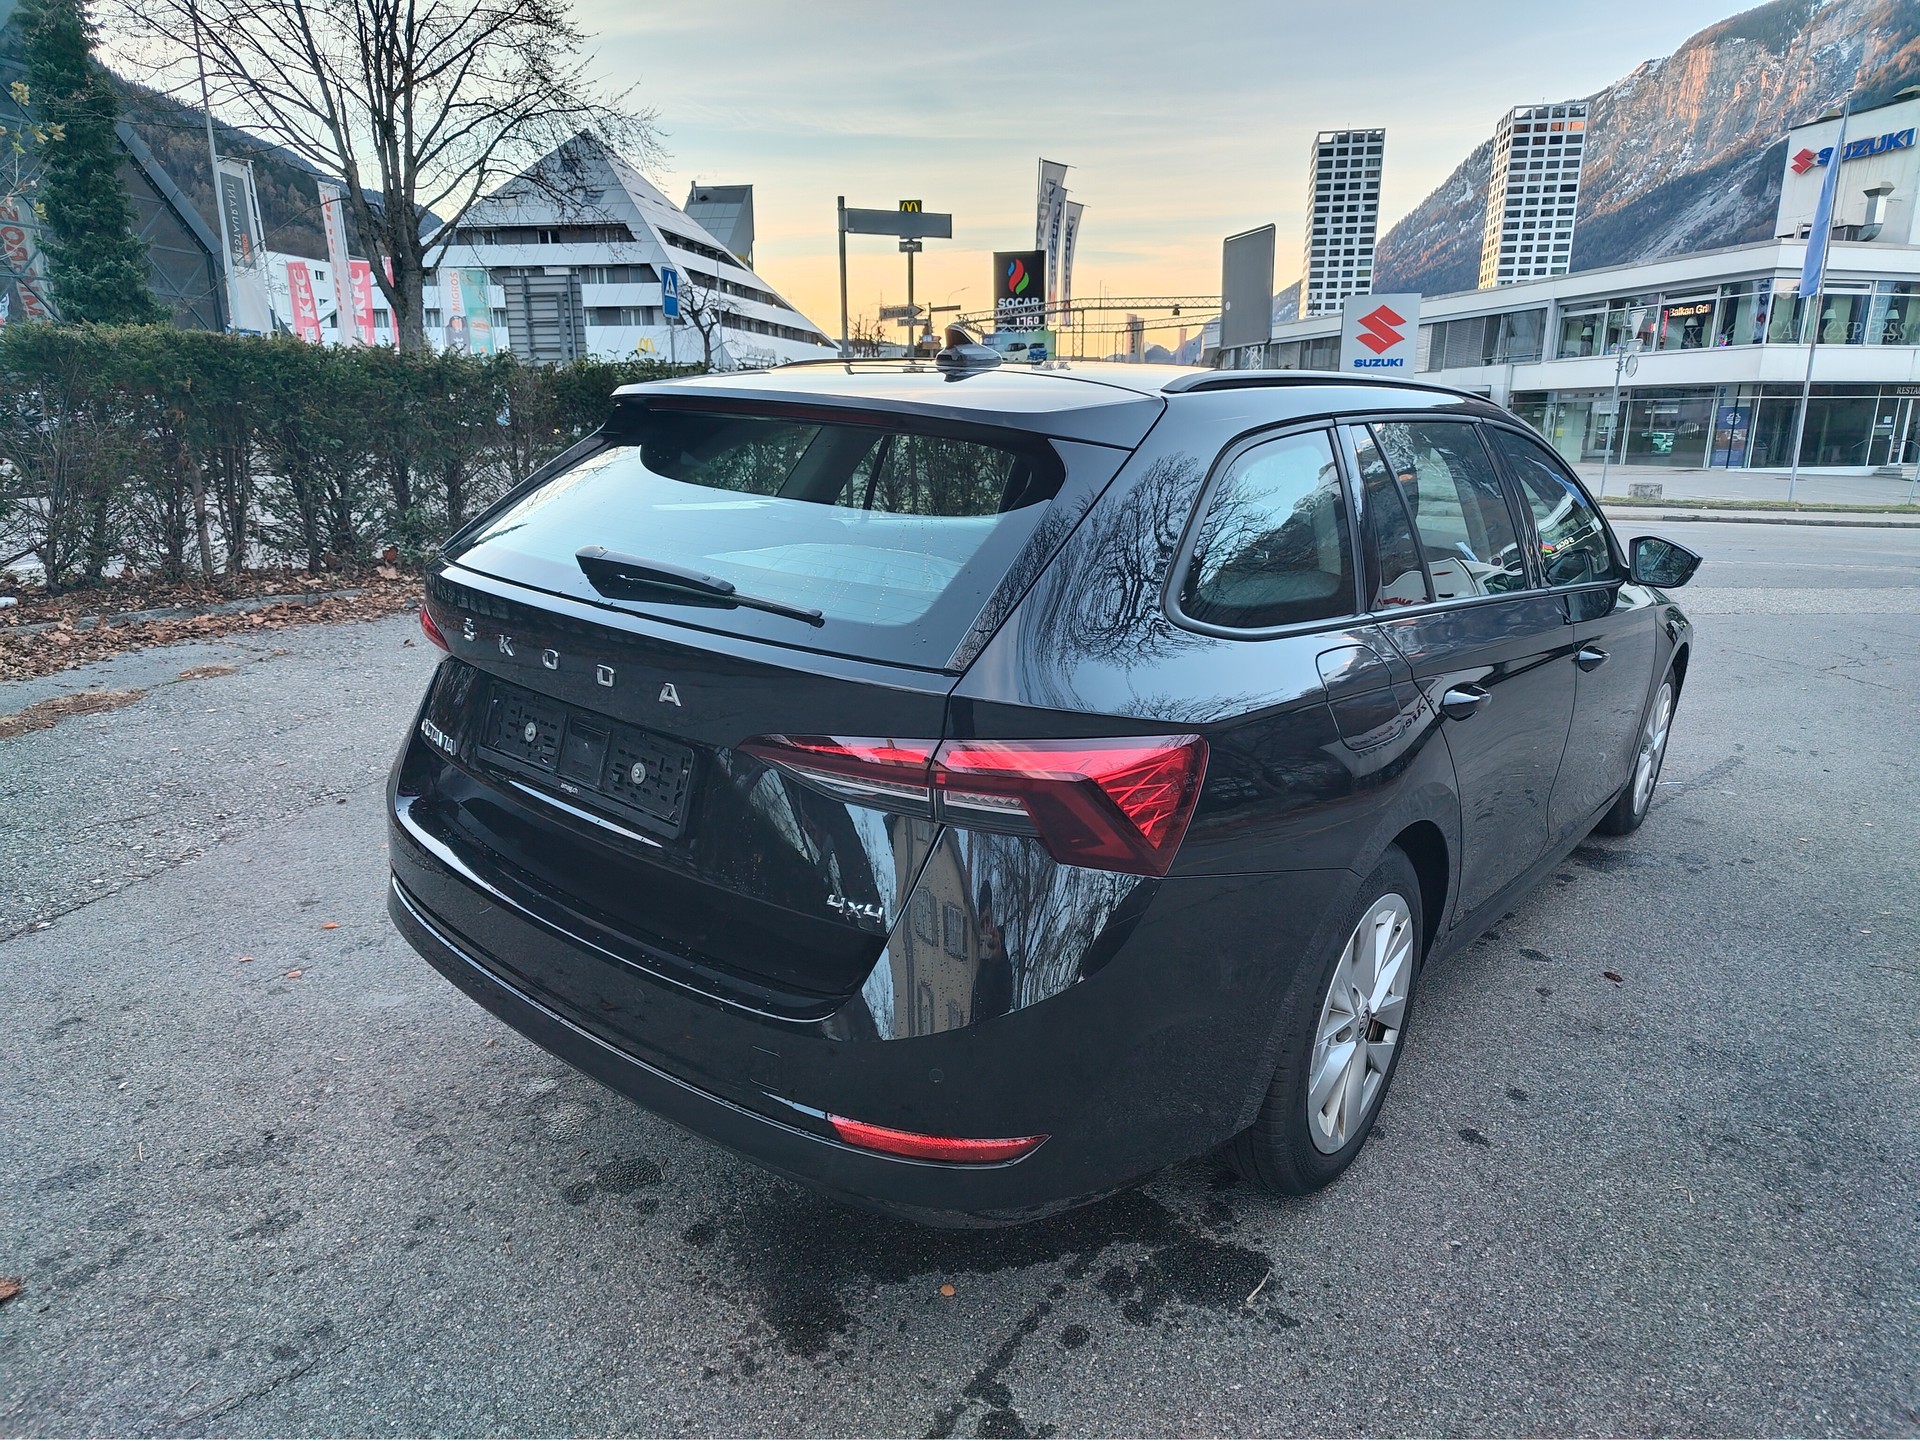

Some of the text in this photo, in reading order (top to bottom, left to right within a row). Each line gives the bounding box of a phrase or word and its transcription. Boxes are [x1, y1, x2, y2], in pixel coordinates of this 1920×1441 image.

[1817, 127, 1917, 167] SUZUKI
[293, 268, 315, 319] KFC
[350, 269, 367, 319] KFC
[450, 272, 461, 312] MIGROS
[1353, 358, 1404, 368] SUZUKI
